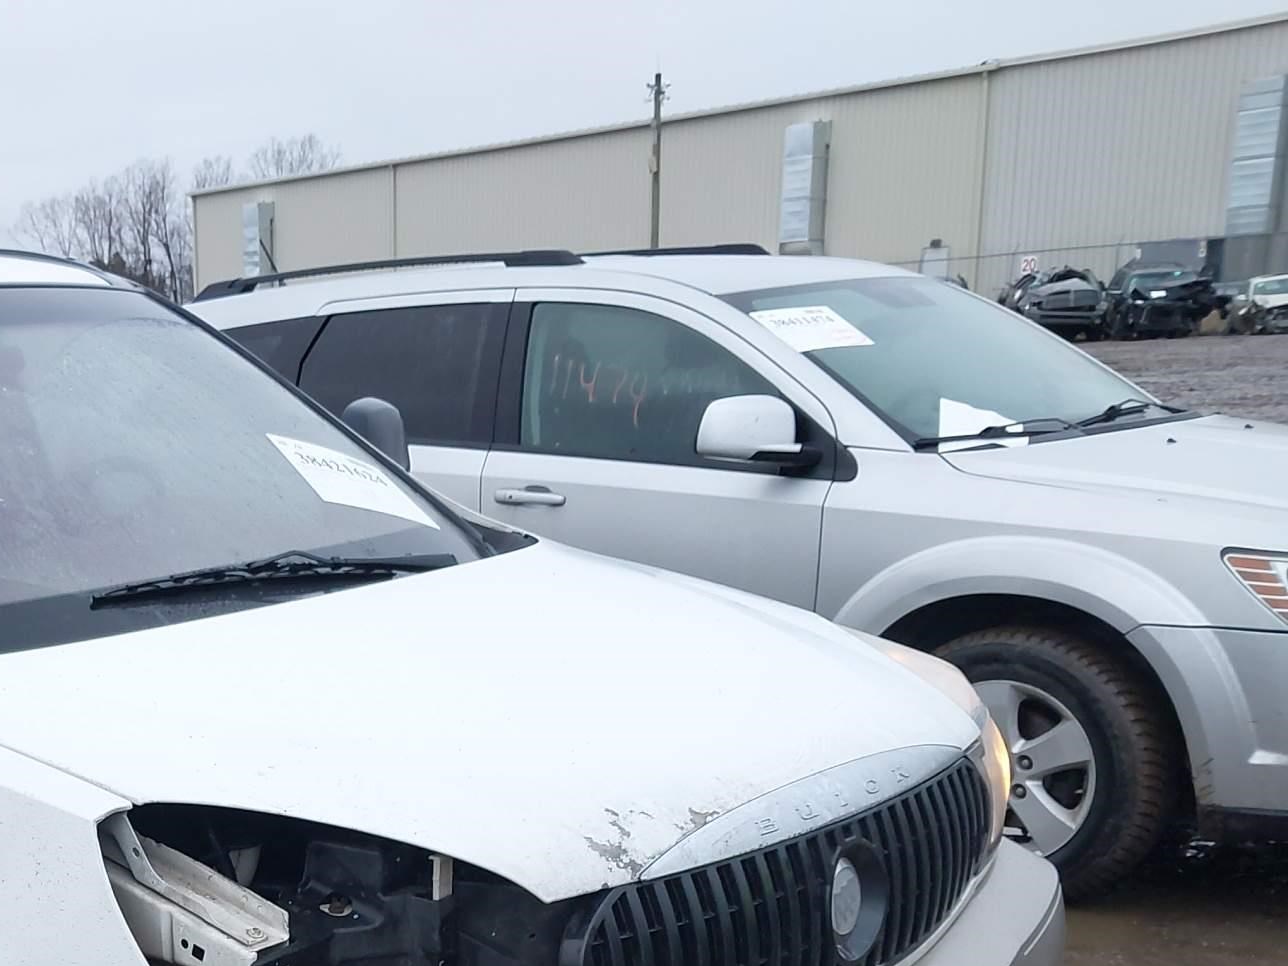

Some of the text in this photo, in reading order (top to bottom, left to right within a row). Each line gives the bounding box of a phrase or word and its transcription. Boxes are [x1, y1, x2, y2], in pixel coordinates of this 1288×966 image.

[1022, 257, 1037, 272] 20
[293, 451, 389, 488] 38421624
[755, 767, 910, 837] BUICK
